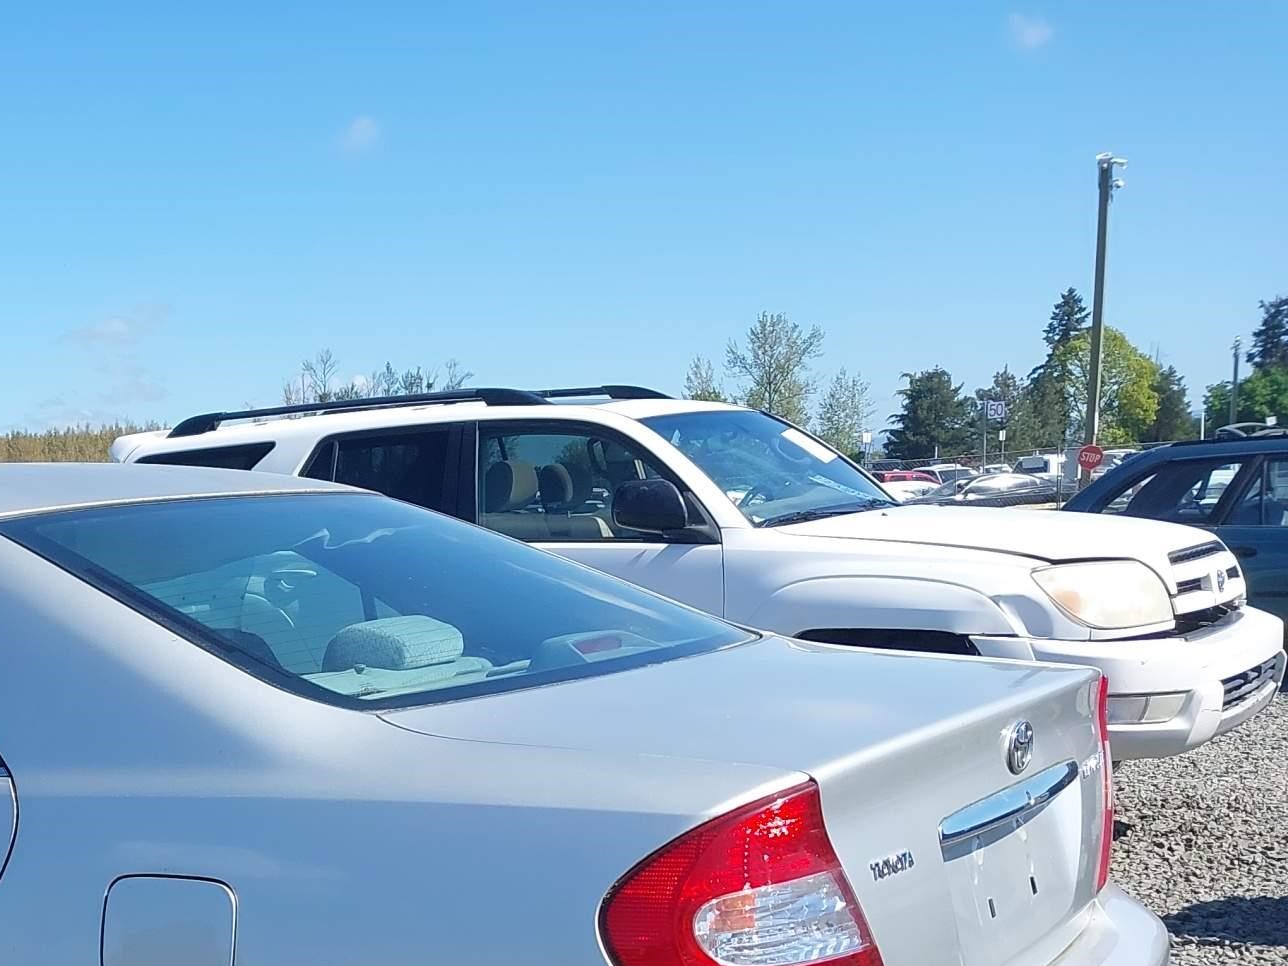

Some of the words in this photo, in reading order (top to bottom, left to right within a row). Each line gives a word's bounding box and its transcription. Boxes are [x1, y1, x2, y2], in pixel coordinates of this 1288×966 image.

[988, 402, 1004, 417] 50
[1080, 451, 1101, 463] STOP
[869, 850, 915, 881] TOYOTA
